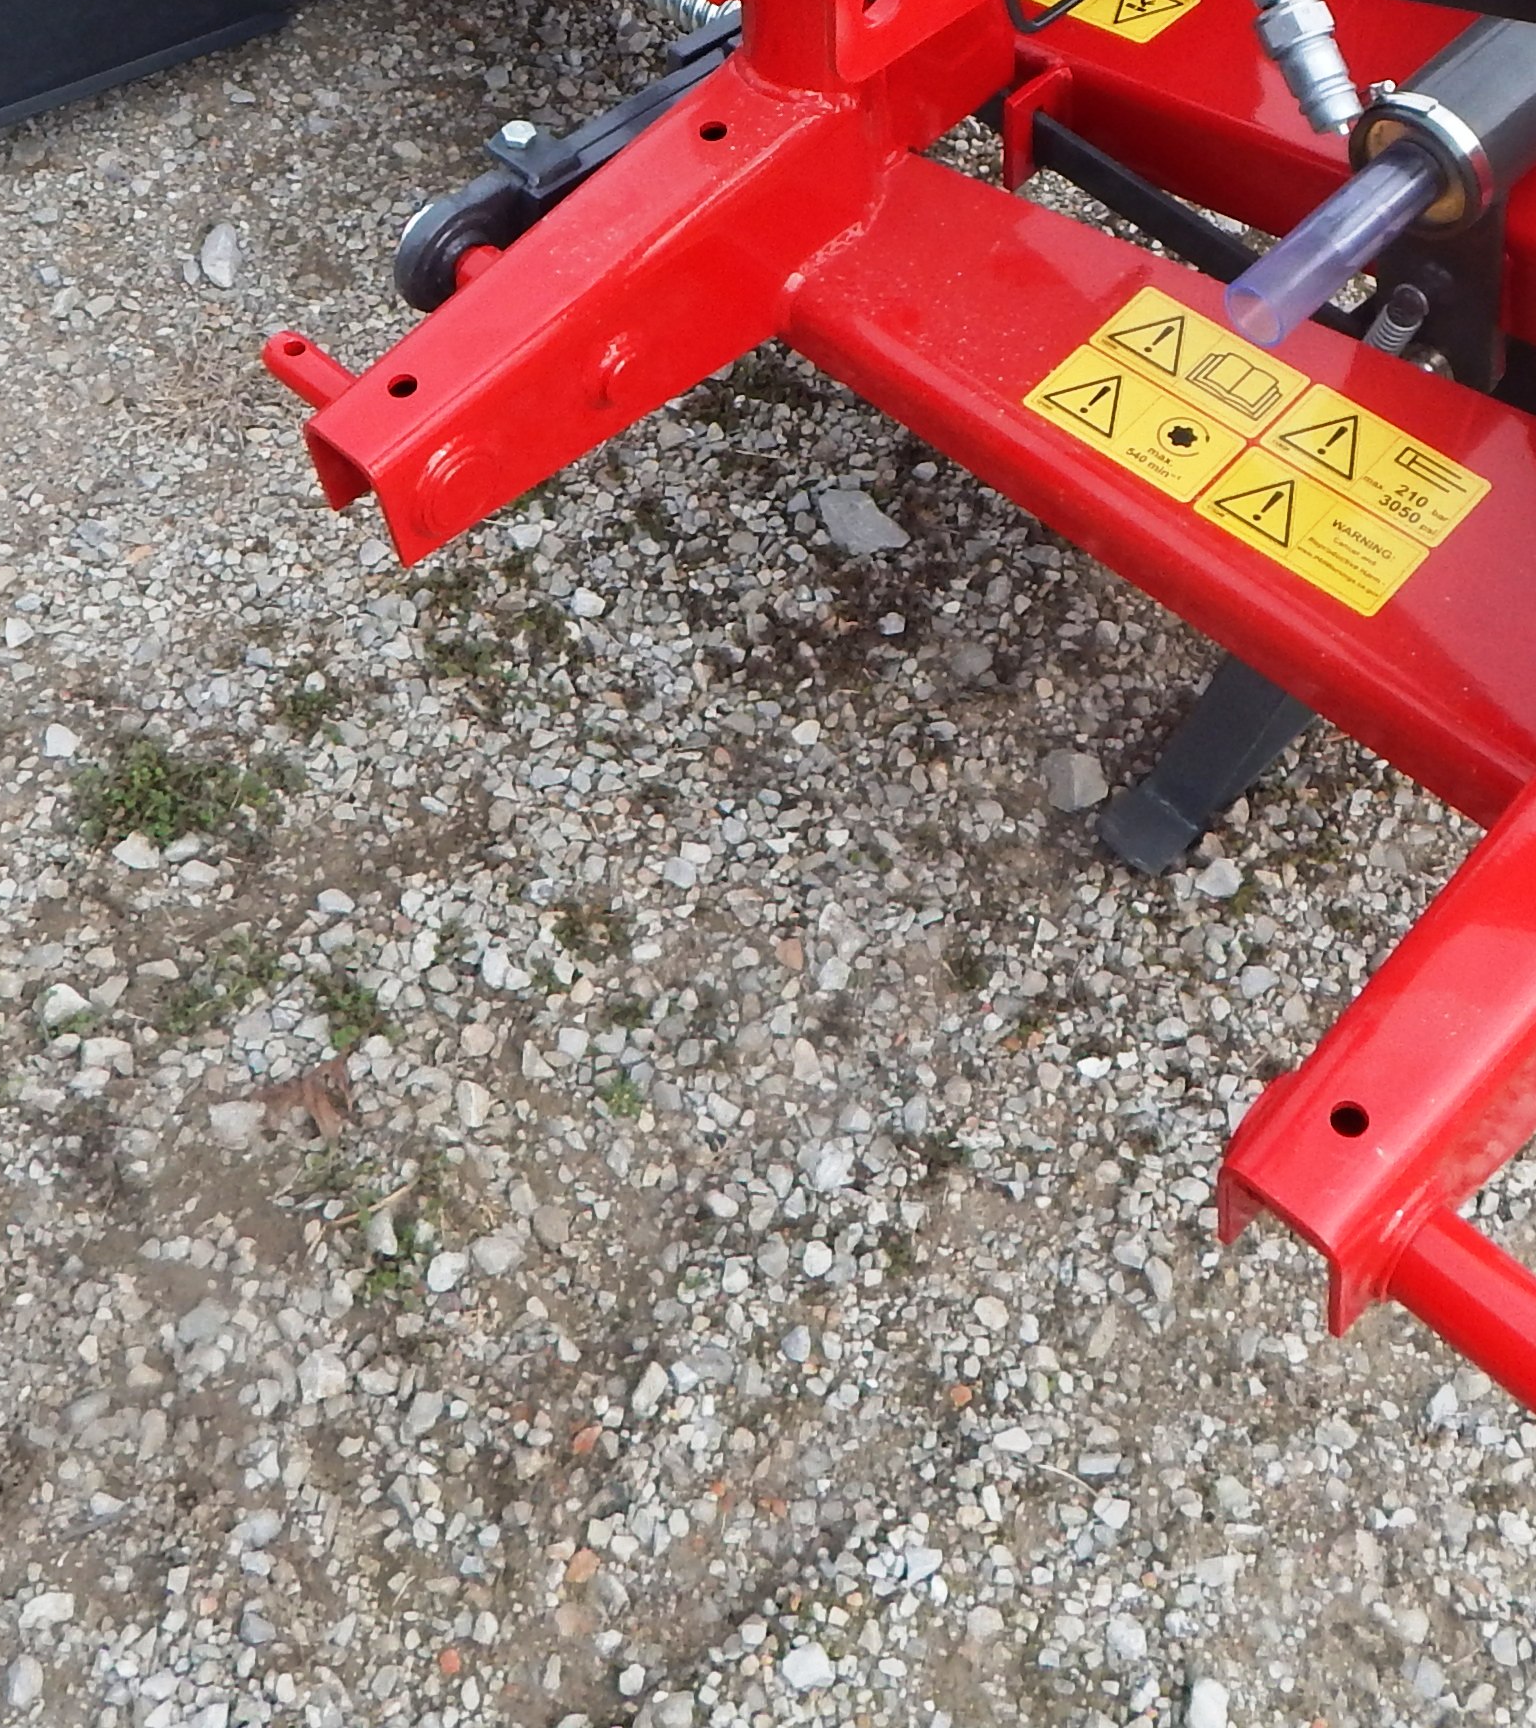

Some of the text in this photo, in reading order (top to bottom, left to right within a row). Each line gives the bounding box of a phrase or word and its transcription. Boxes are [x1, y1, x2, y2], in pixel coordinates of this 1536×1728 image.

[1126, 447, 1148, 463] 540
[1378, 494, 1421, 523] 3050
[1394, 484, 1429, 507] 210
[1431, 508, 1449, 521] bar
